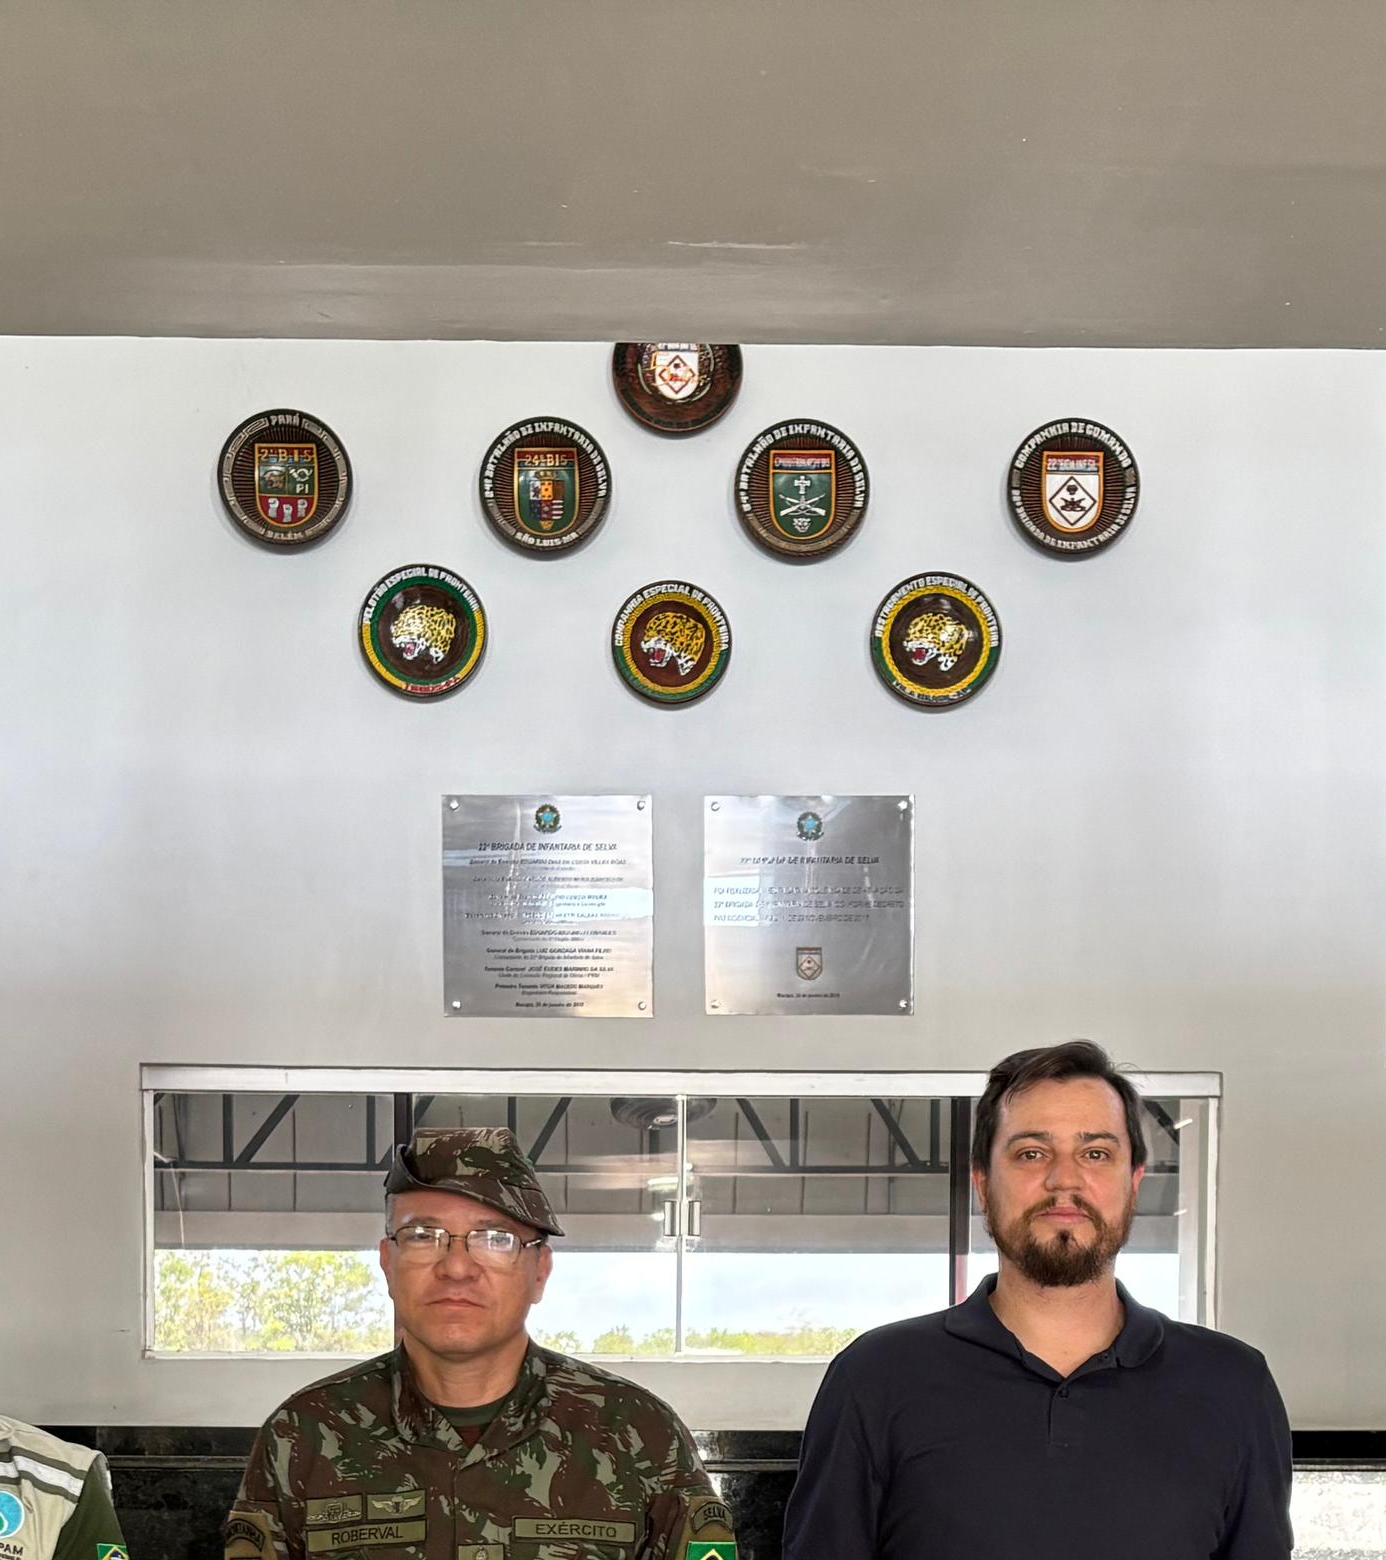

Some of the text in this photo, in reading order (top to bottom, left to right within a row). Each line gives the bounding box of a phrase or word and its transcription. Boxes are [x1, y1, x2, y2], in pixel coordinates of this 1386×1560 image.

[534, 422, 594, 454] INFANTARIA
[788, 424, 855, 458] INFANTARIA
[1014, 422, 1132, 468] COMPANHIA DE COMANDO
[296, 484, 309, 493] PI
[386, 567, 428, 588] ESPECIAL
[926, 576, 967, 592] ESPECIAL
[643, 584, 691, 599] ESPECIAL
[702, 598, 729, 650] FRONTEIRA
[491, 843, 524, 851] BRIGADA
[526, 843, 536, 851] DE
[538, 843, 580, 851] INFANTARIA
[583, 843, 592, 851] DE
[332, 1526, 403, 1545] ROBERVAL
[536, 1522, 617, 1538] EXÉRCITO
